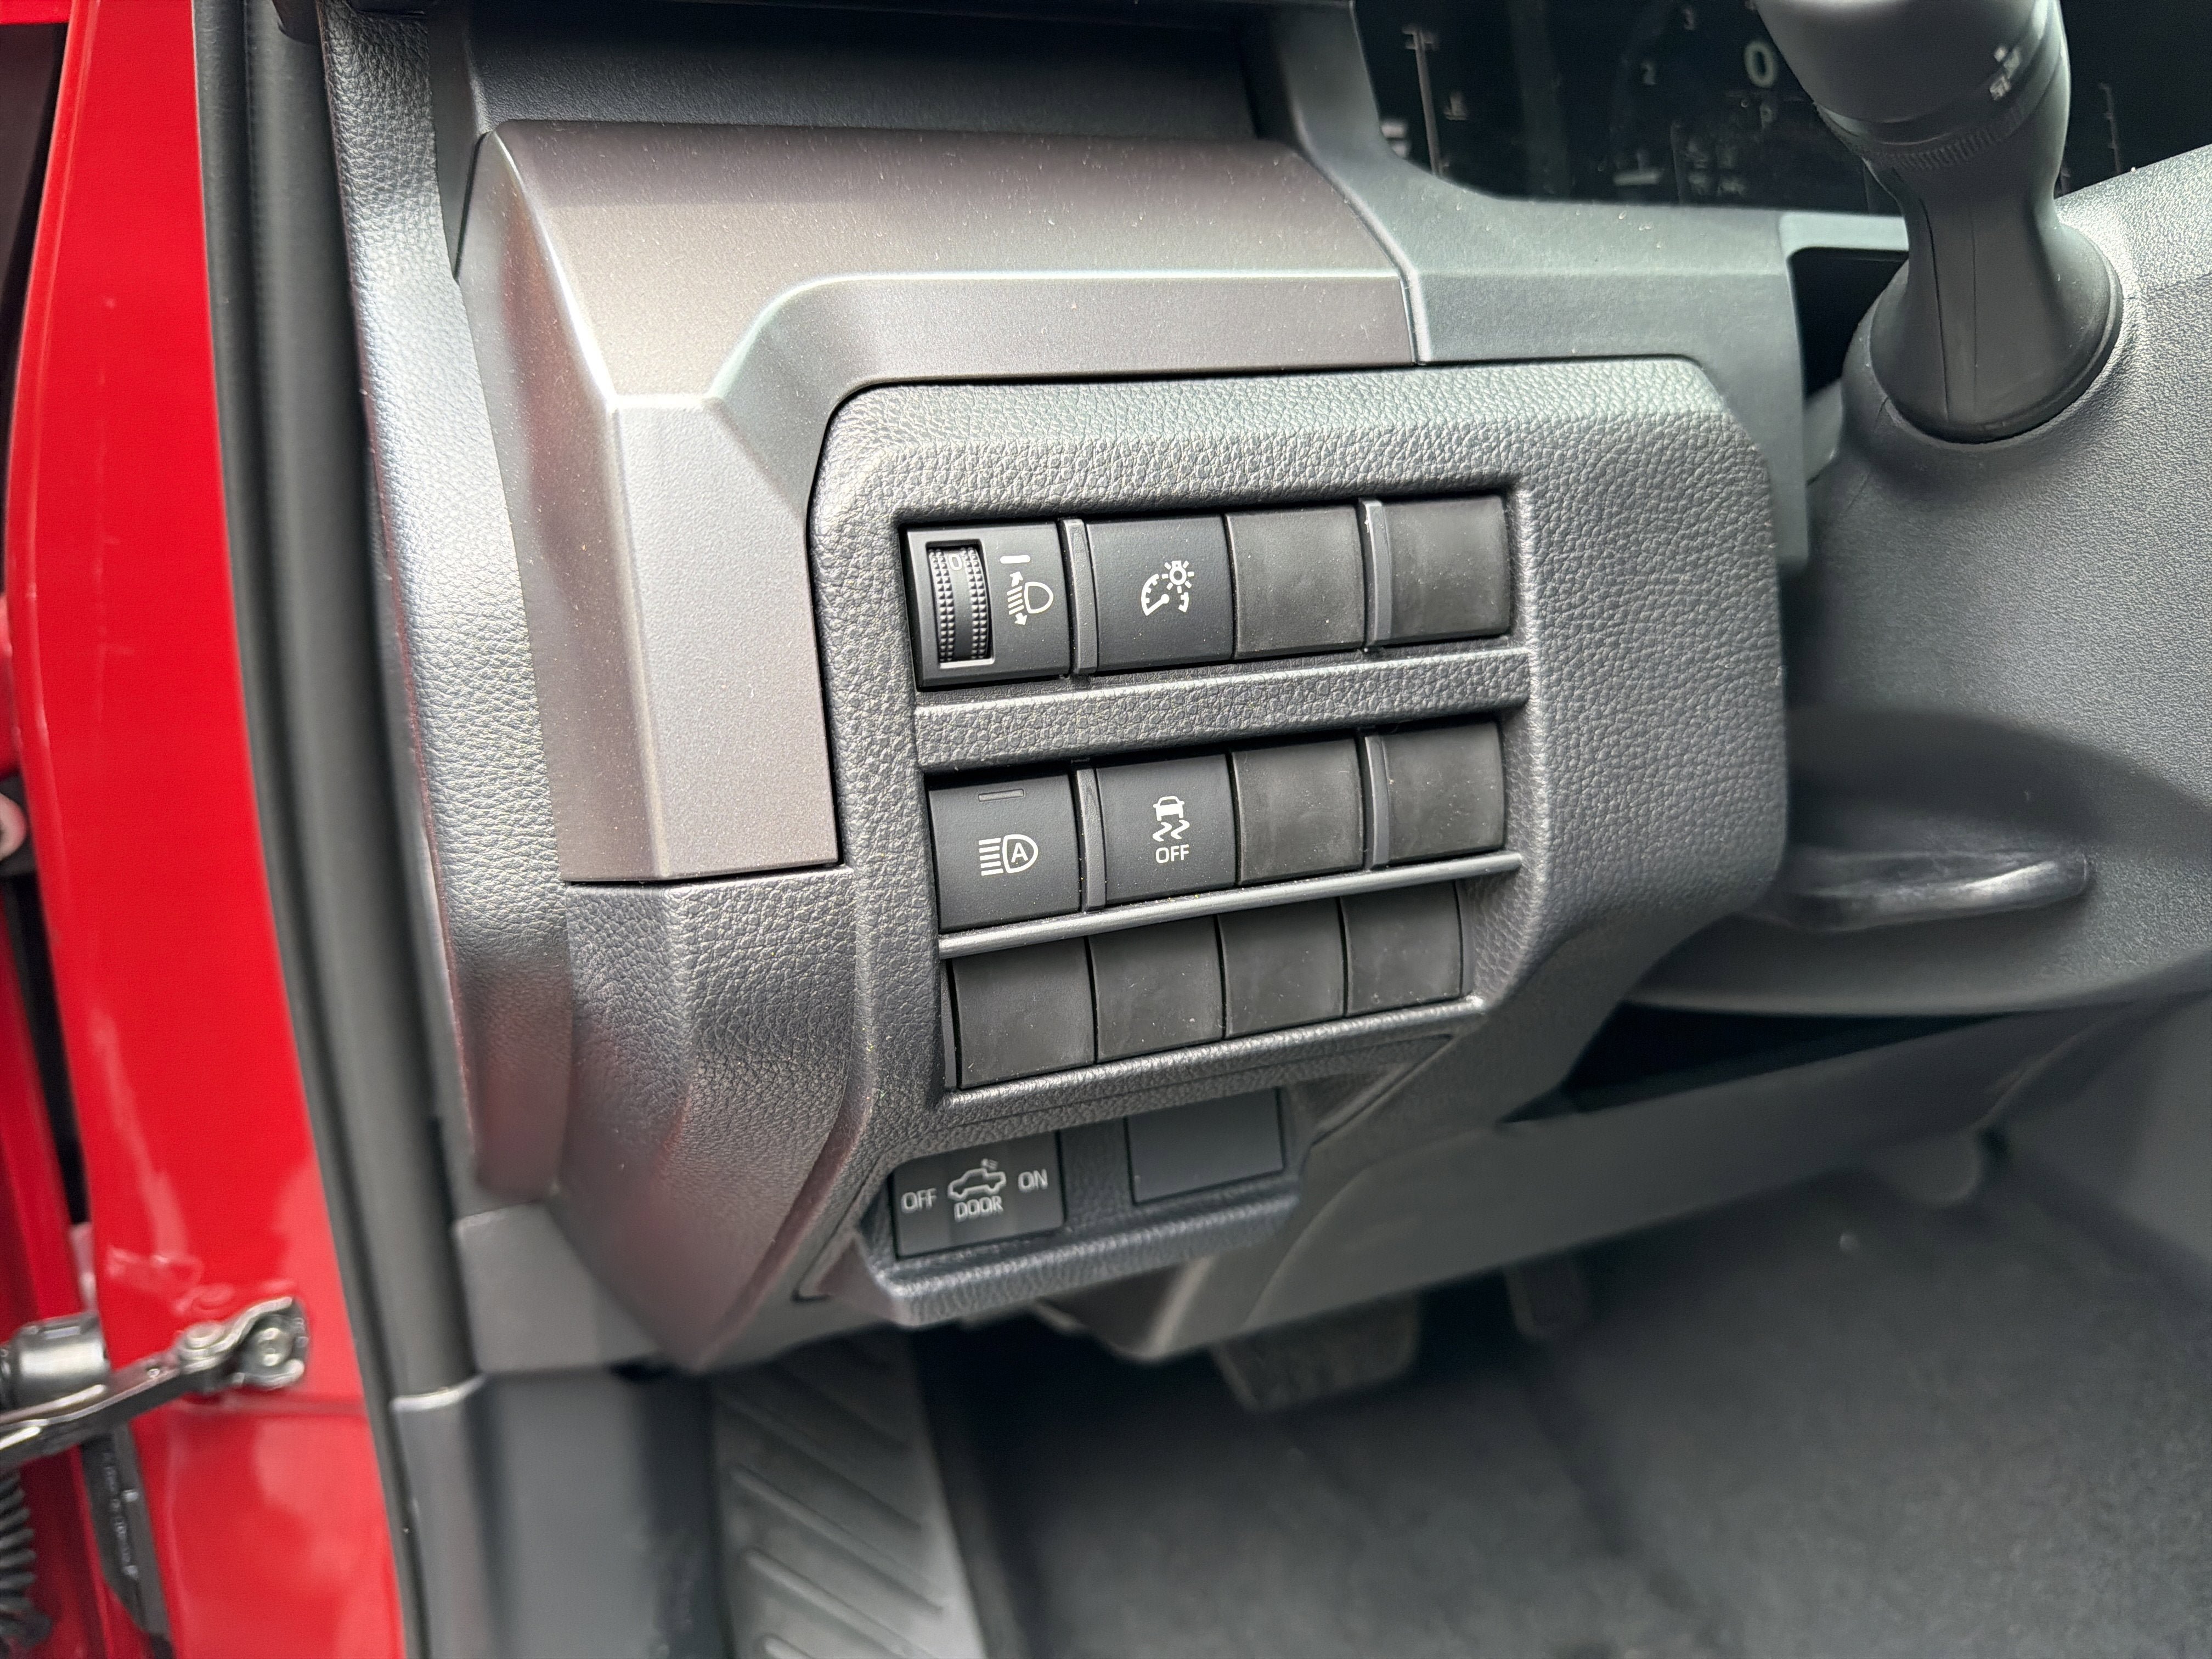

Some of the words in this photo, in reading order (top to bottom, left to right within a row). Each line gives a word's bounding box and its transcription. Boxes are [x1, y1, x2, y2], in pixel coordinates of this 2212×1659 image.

[1744, 41, 1778, 88] 0
[948, 553, 963, 571] 0
[1011, 842, 1029, 864] A
[1155, 843, 1190, 864] OFF
[1018, 1169, 1048, 1192] ON
[901, 1188, 937, 1213] OFF
[953, 1195, 1003, 1222] DOOR
